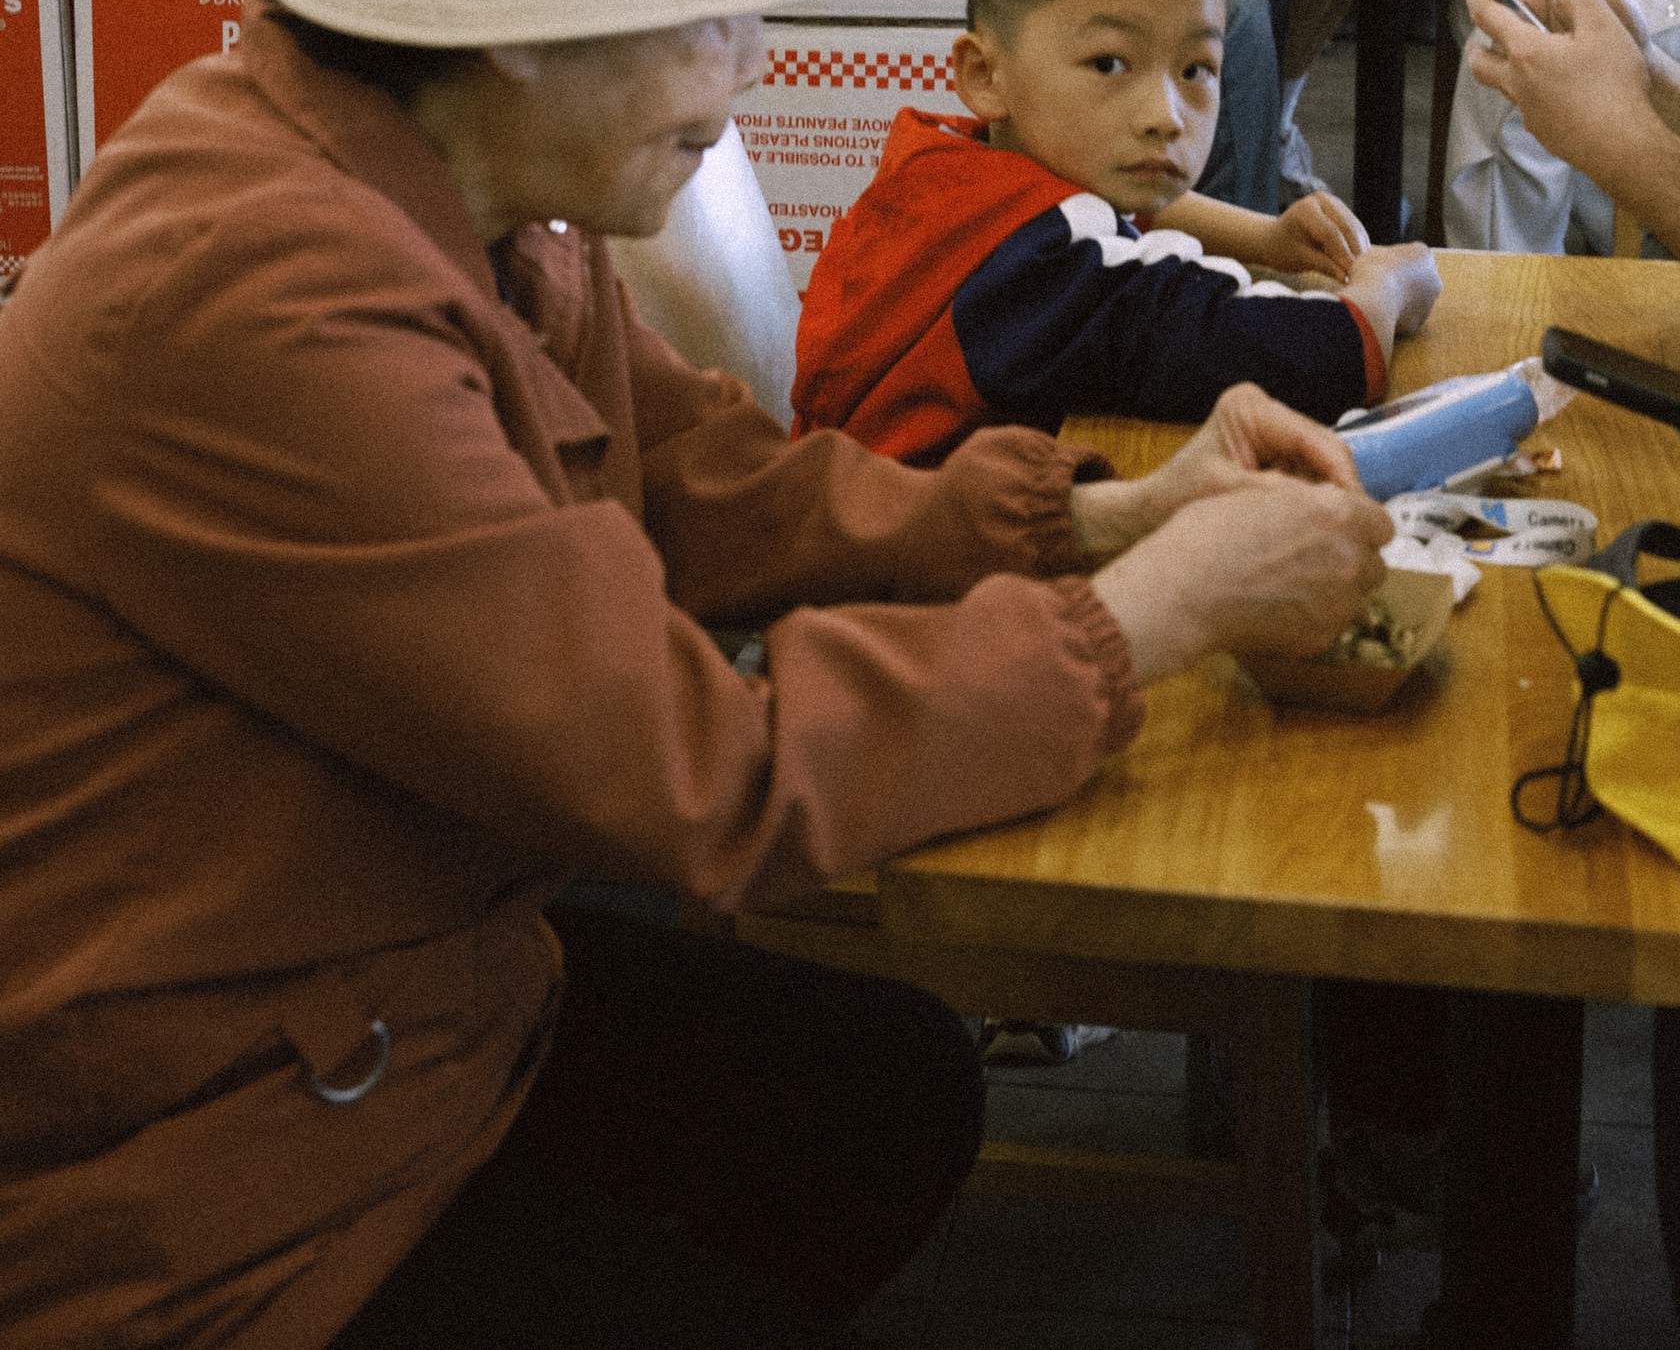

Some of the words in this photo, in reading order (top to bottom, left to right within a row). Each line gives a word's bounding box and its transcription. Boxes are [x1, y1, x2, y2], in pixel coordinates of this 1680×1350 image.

[776, 115, 847, 130] PEANUTS
[751, 132, 809, 147] PLEASE
[766, 150, 841, 167] POSSIBLE
[845, 153, 865, 168] TO
[768, 203, 842, 218] ROASTED
